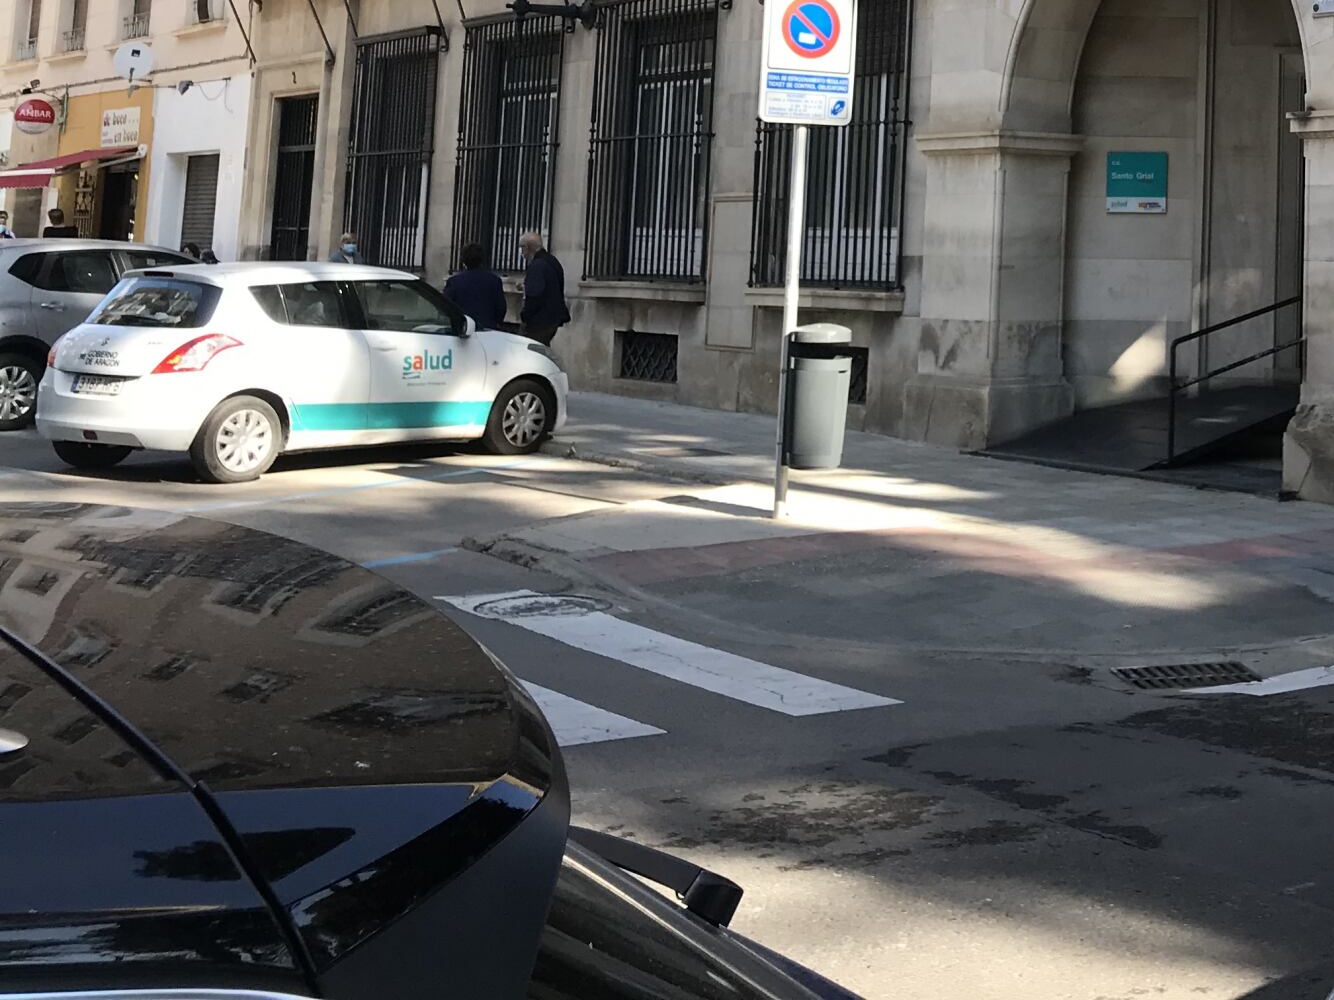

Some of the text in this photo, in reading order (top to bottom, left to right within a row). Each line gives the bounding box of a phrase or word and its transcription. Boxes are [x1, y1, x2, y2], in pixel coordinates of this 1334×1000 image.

[19, 109, 51, 118] AMBAR
[1111, 172, 1154, 180] Santo Grial
[87, 350, 118, 359] GOBIERNO
[85, 358, 93, 366] DE
[403, 349, 453, 371] salud
